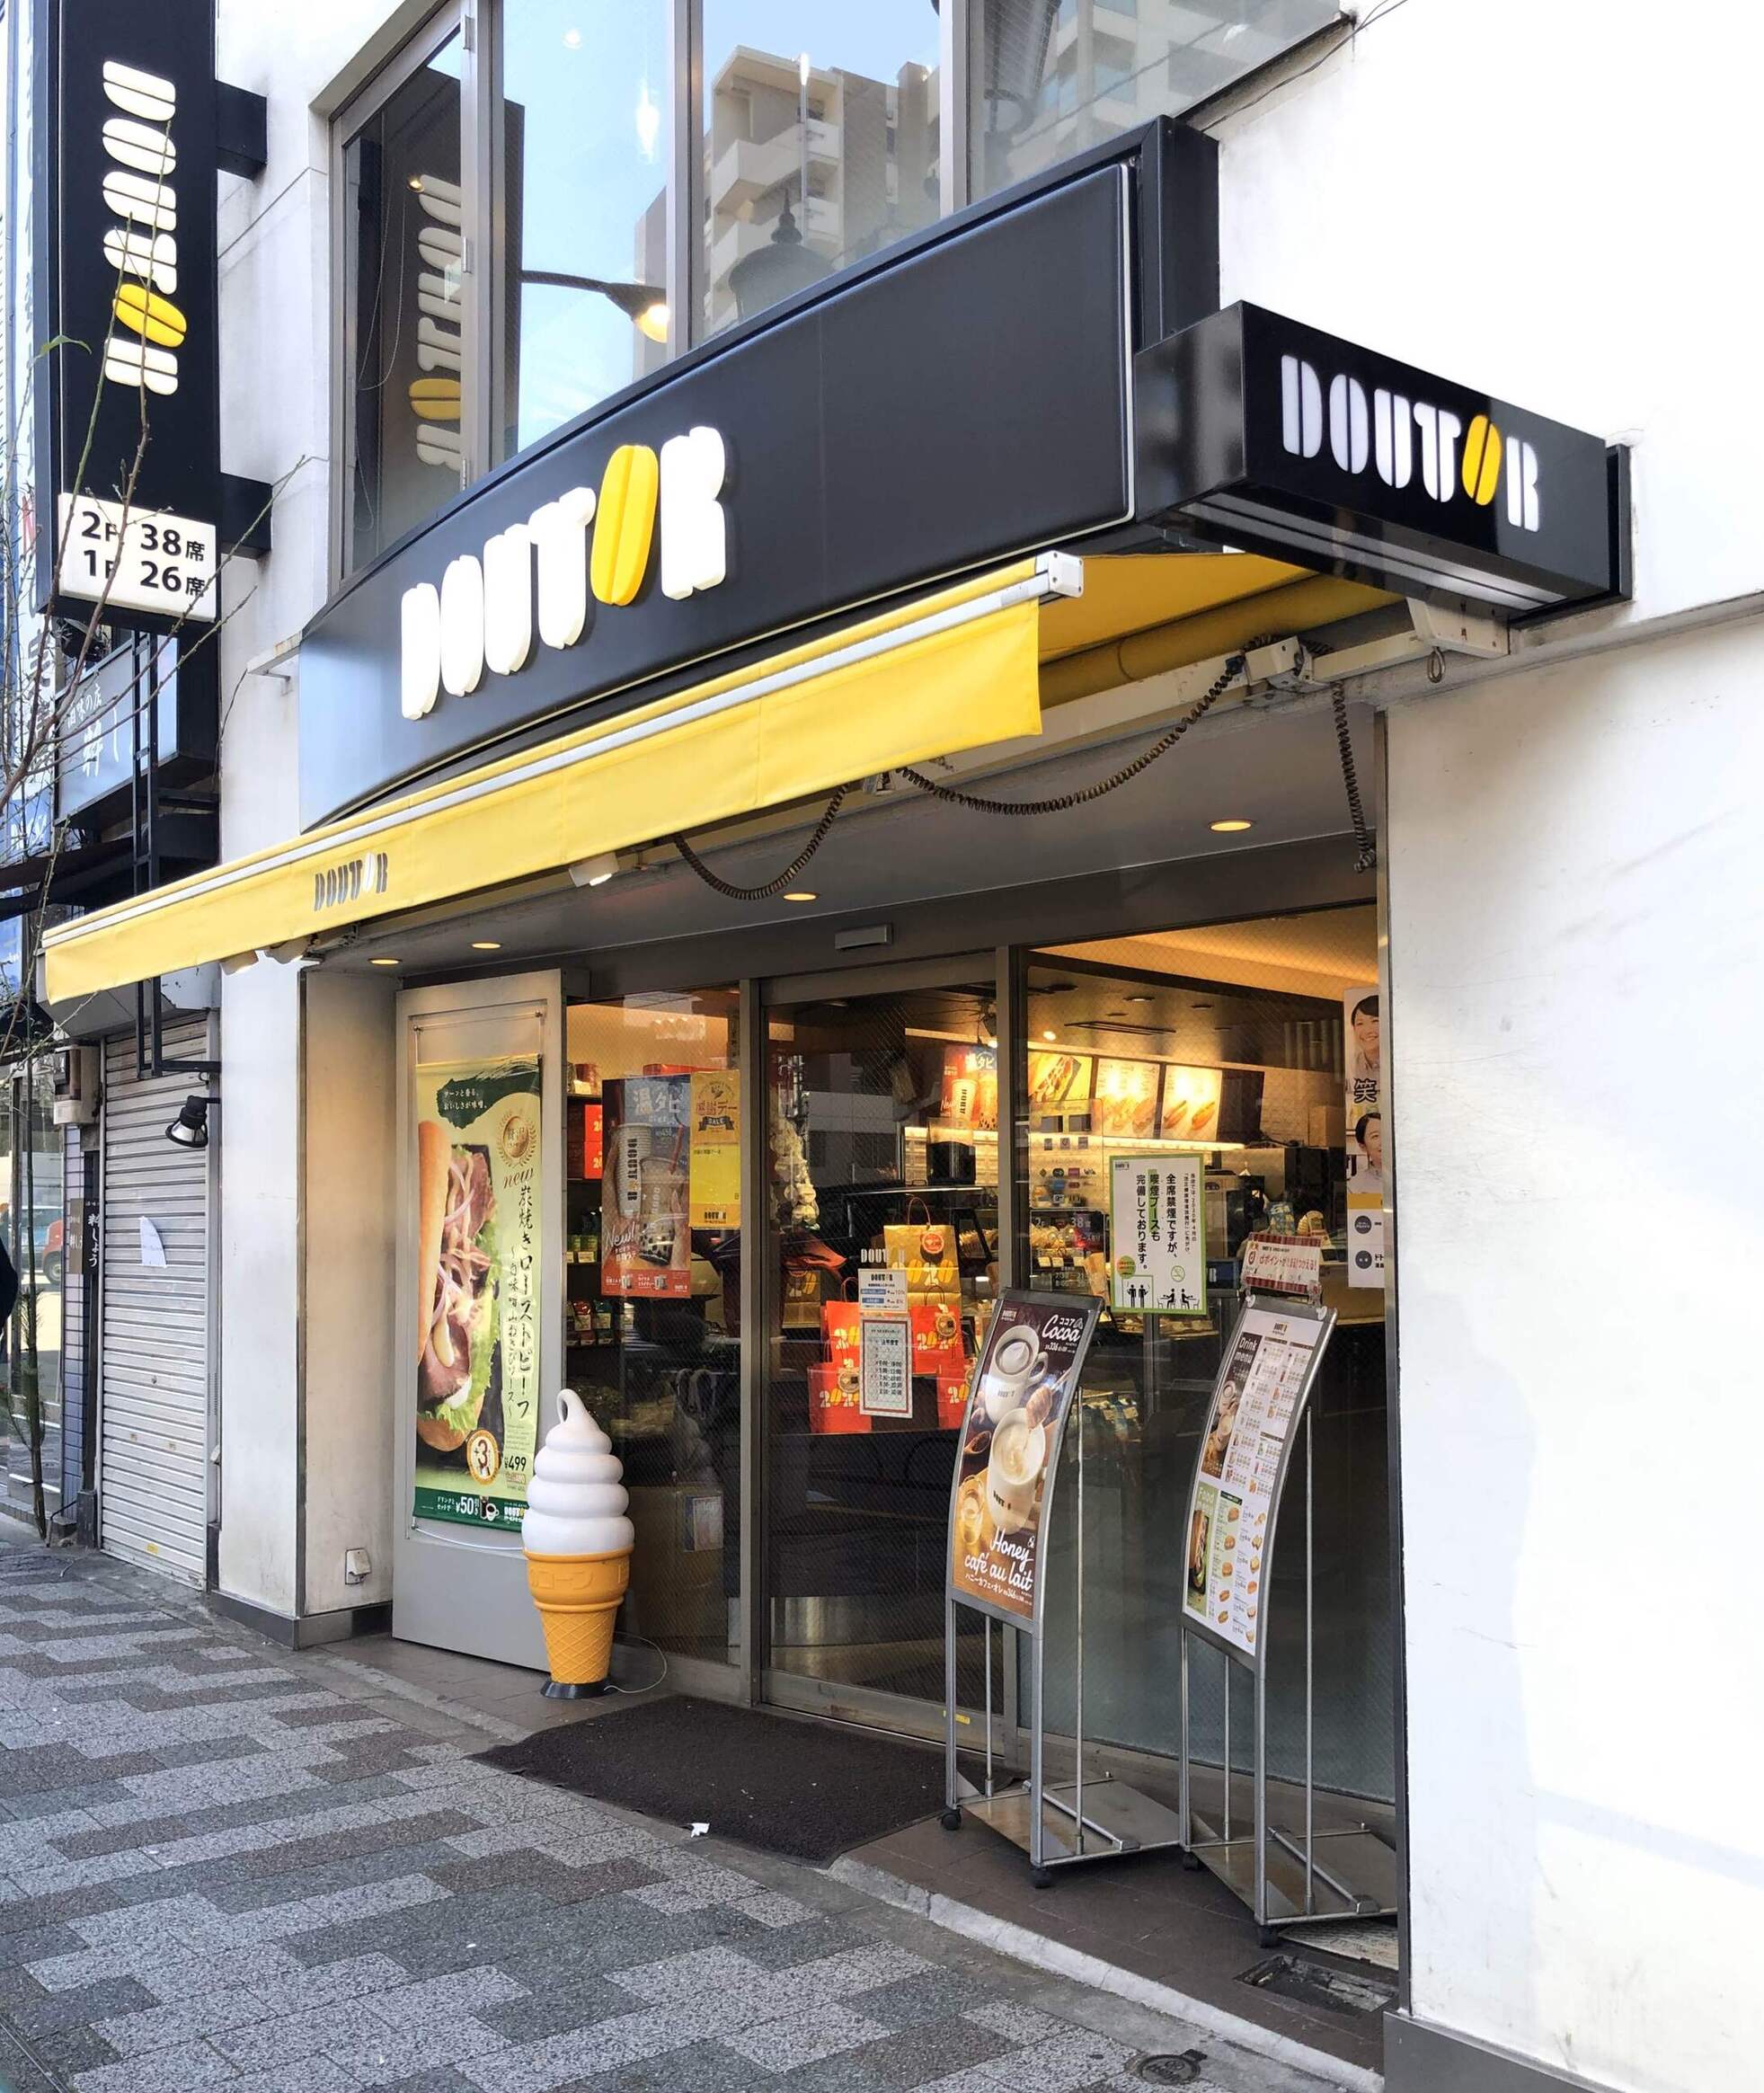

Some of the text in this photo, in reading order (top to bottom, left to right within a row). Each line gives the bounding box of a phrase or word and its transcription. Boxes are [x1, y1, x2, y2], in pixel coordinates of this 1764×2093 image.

[102, 60, 187, 395] DOUTOR
[1281, 353, 1541, 533] DOUTOR
[140, 523, 206, 563] 38席
[401, 426, 727, 721] DOUTOR
[315, 852, 388, 912] DOUTOR
[1353, 1079, 1378, 1104] 笑
[504, 1168, 534, 1189] new
[627, 1138, 638, 1202] DOUTOR
[1136, 1174, 1148, 1270] 完備しております。
[1150, 1174, 1161, 1242] 喫煙ブースも
[1166, 1174, 1178, 1258] 全席禁煙ですが、
[517, 1184, 534, 1419] 炭焼きローストビーフ
[1042, 1314, 1081, 1343] Cocoa
[1233, 1351, 1254, 1365] menu
[1238, 1336, 1258, 1352] Drink
[964, 1552, 1033, 1592] café au lait
[990, 1527, 1035, 1573] Honey
